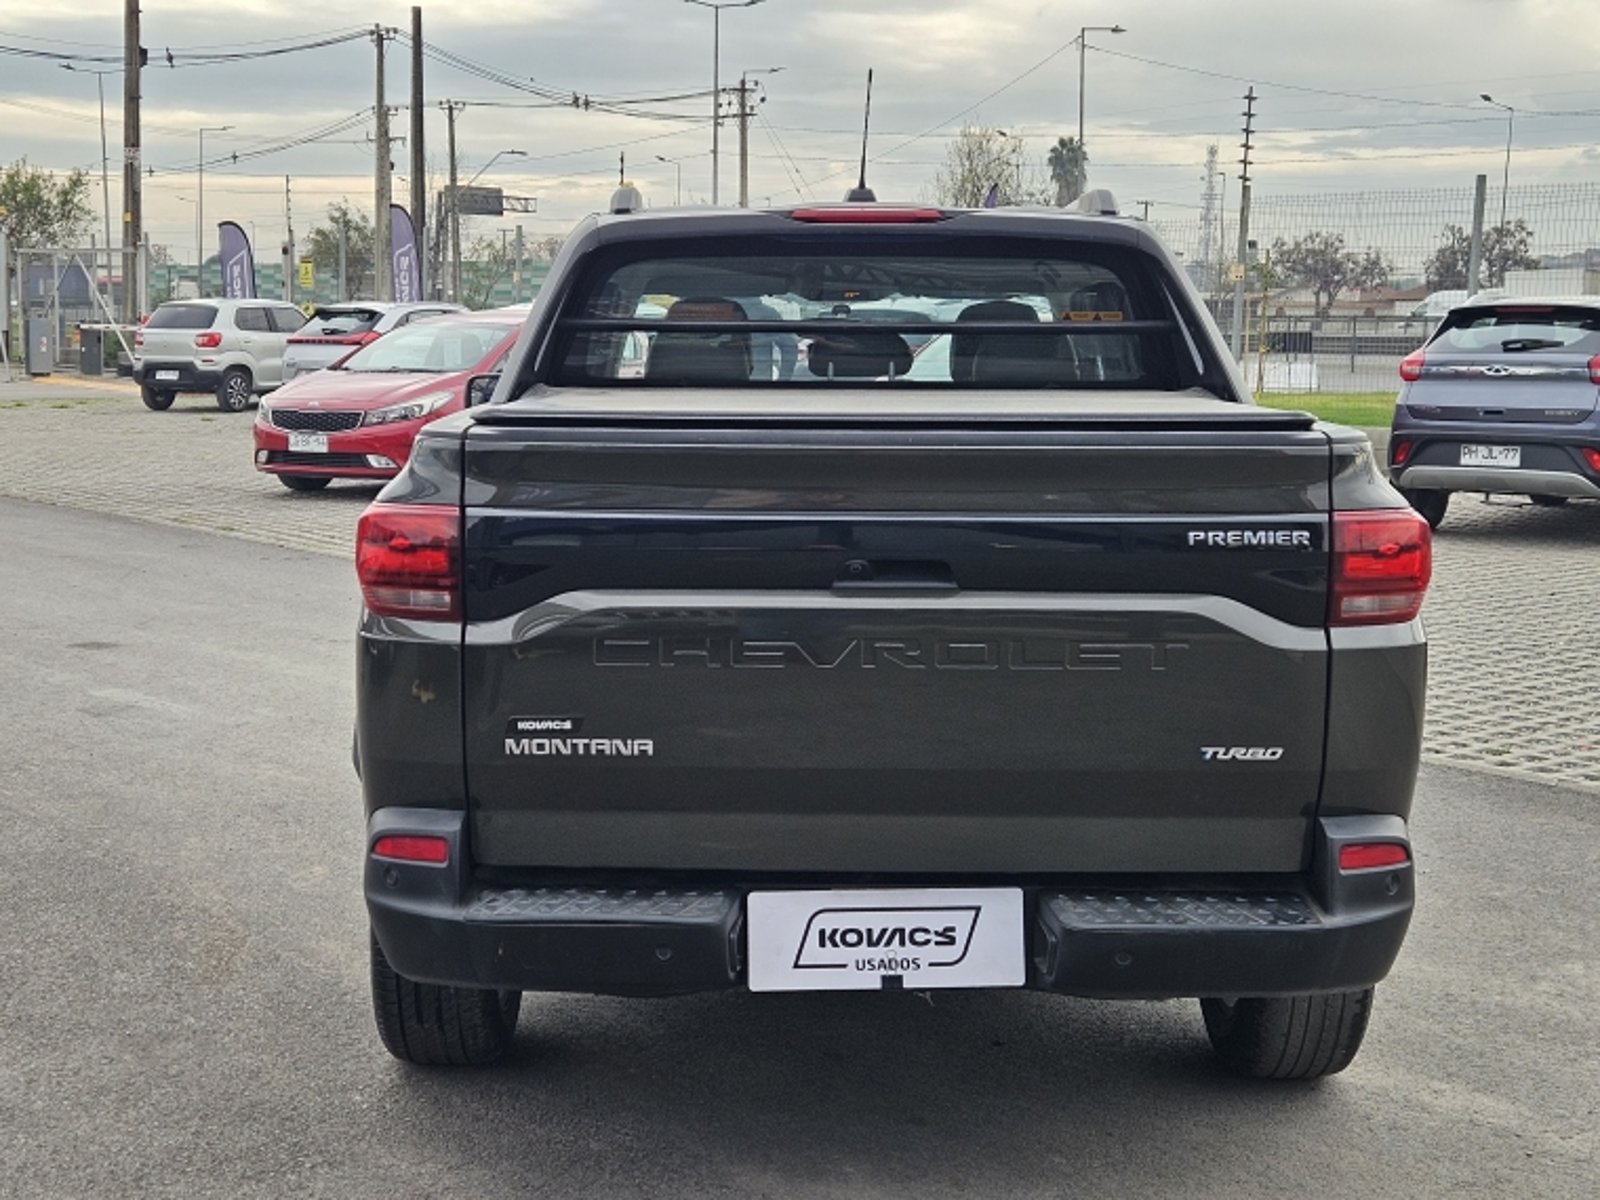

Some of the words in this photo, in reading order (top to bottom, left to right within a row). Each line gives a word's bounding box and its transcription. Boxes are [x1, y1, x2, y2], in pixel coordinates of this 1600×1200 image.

[1187, 530, 1311, 546] PREMIER
[592, 636, 1190, 671] CHEVROLET
[517, 719, 573, 730] KOVACS
[504, 738, 654, 756] MONTANA
[1200, 746, 1285, 761] TURBO
[818, 926, 957, 948] KOVACS
[854, 957, 922, 972] USADOS
